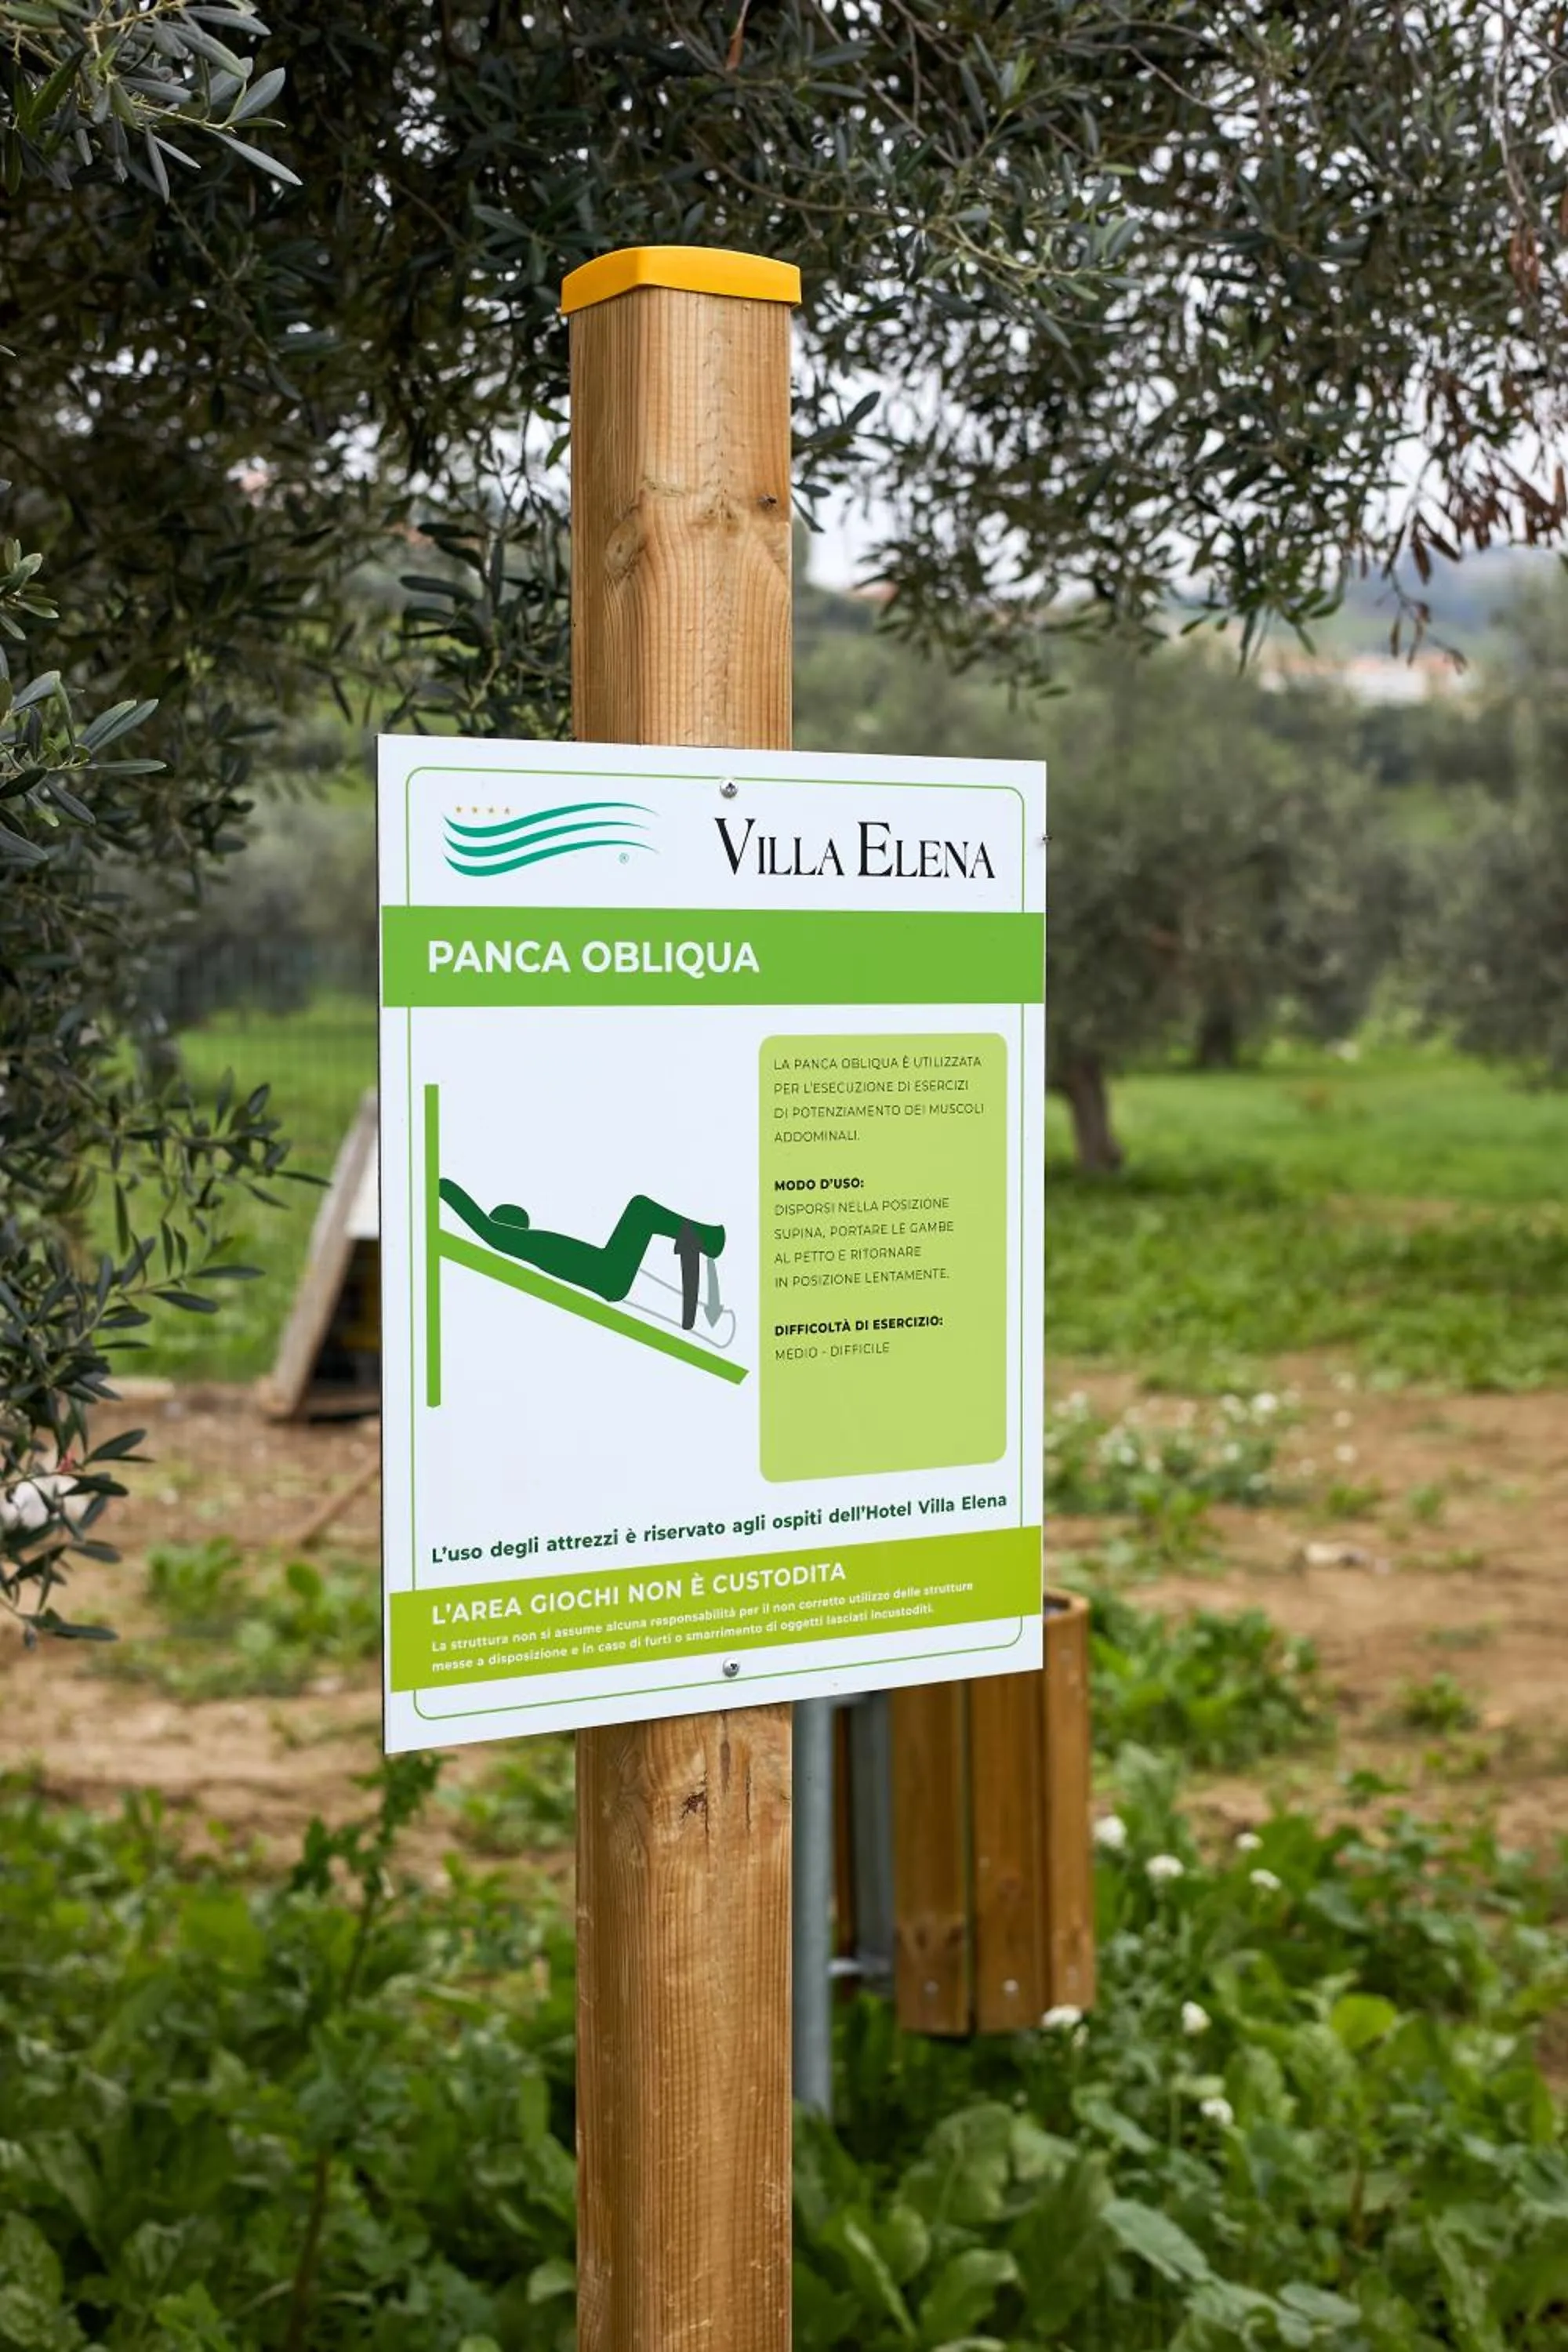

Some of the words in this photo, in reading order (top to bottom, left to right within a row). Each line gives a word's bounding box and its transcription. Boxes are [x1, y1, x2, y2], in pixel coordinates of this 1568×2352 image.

[429, 941, 570, 972] PANCA
[582, 941, 759, 977] OBLIQUA
[775, 1060, 789, 1070] LA
[795, 1058, 837, 1069] PANCA
[842, 1058, 898, 1069] OBLIQUA
[903, 1055, 909, 1068] È
[914, 1057, 981, 1067] UTILIZZATA
[775, 1083, 798, 1094] PER
[804, 1082, 893, 1094] L'ESECUZIONE
[898, 1081, 909, 1091] DI
[915, 1080, 967, 1091] ESERCIZI
[775, 1108, 787, 1118] DI
[793, 1105, 900, 1118] POTENZIAMENTO
[905, 1105, 924, 1115] DEI
[930, 1104, 983, 1114] MUSCOLI
[775, 1131, 859, 1142] ADDOMINALI.
[775, 1179, 815, 1190] MODO
[775, 1203, 834, 1215] DISPORSI
[839, 1201, 878, 1212] NELLA
[883, 1198, 949, 1210] POSIZIONE
[775, 1227, 825, 1239] SUPINA,
[831, 1225, 887, 1236] PORTARE
[892, 1222, 905, 1234] LE
[909, 1221, 953, 1232] GAMBE
[775, 1253, 790, 1263] AL
[795, 1251, 834, 1262] PETTO
[839, 1250, 846, 1261] E
[851, 1247, 920, 1259] RITORNARE
[775, 1277, 787, 1287] IN
[793, 1273, 860, 1286] POSIZIONE
[866, 1269, 949, 1283] LENTAMENTE.
[775, 1319, 851, 1336] DIFFICOLTÀ
[856, 1320, 868, 1330] DI
[873, 1316, 942, 1330] ESERCIZIO:
[775, 1347, 817, 1359] MEDIO
[831, 1342, 889, 1357] DIFFICILE
[433, 1547, 482, 1563] L'uso
[491, 1537, 538, 1559] degli
[547, 1529, 618, 1551] attrezzi
[626, 1526, 637, 1543] è
[644, 1523, 725, 1541] riservato
[733, 1515, 765, 1535] agli
[773, 1509, 822, 1530] ospiti
[829, 1501, 911, 1523] dell'Hotel
[919, 1498, 954, 1514] Villa
[963, 1495, 1006, 1510] Elena
[433, 1597, 522, 1624] L'AREA
[530, 1587, 619, 1613] GIOCHI
[629, 1581, 681, 1602] NON
[691, 1574, 704, 1595] È
[713, 1563, 845, 1593] CUSTODITA
[432, 1642, 446, 1651] La
[452, 1636, 508, 1650] struttura
[512, 1632, 537, 1642] non
[541, 1629, 550, 1639] si
[555, 1625, 602, 1637] assume
[606, 1620, 647, 1631] alcuna
[650, 1608, 735, 1626] responsabilità
[739, 1607, 758, 1618] per
[763, 1603, 769, 1613] il
[773, 1602, 796, 1612] non
[798, 1597, 846, 1610] corretto
[849, 1592, 891, 1603] utilizzo
[894, 1588, 921, 1599] delle
[924, 1583, 973, 1595] strutture
[432, 1660, 473, 1671] messe
[488, 1649, 567, 1665] disposizione
[583, 1643, 594, 1653] in
[598, 1642, 626, 1652] caso
[630, 1638, 641, 1648] di
[644, 1635, 671, 1646] furti
[674, 1635, 683, 1643] o
[685, 1625, 763, 1641] smarrimento
[766, 1621, 779, 1632] di
[780, 1617, 822, 1631] oggetti
[826, 1613, 867, 1624] lasciati
[871, 1604, 934, 1619] incustoditi.
